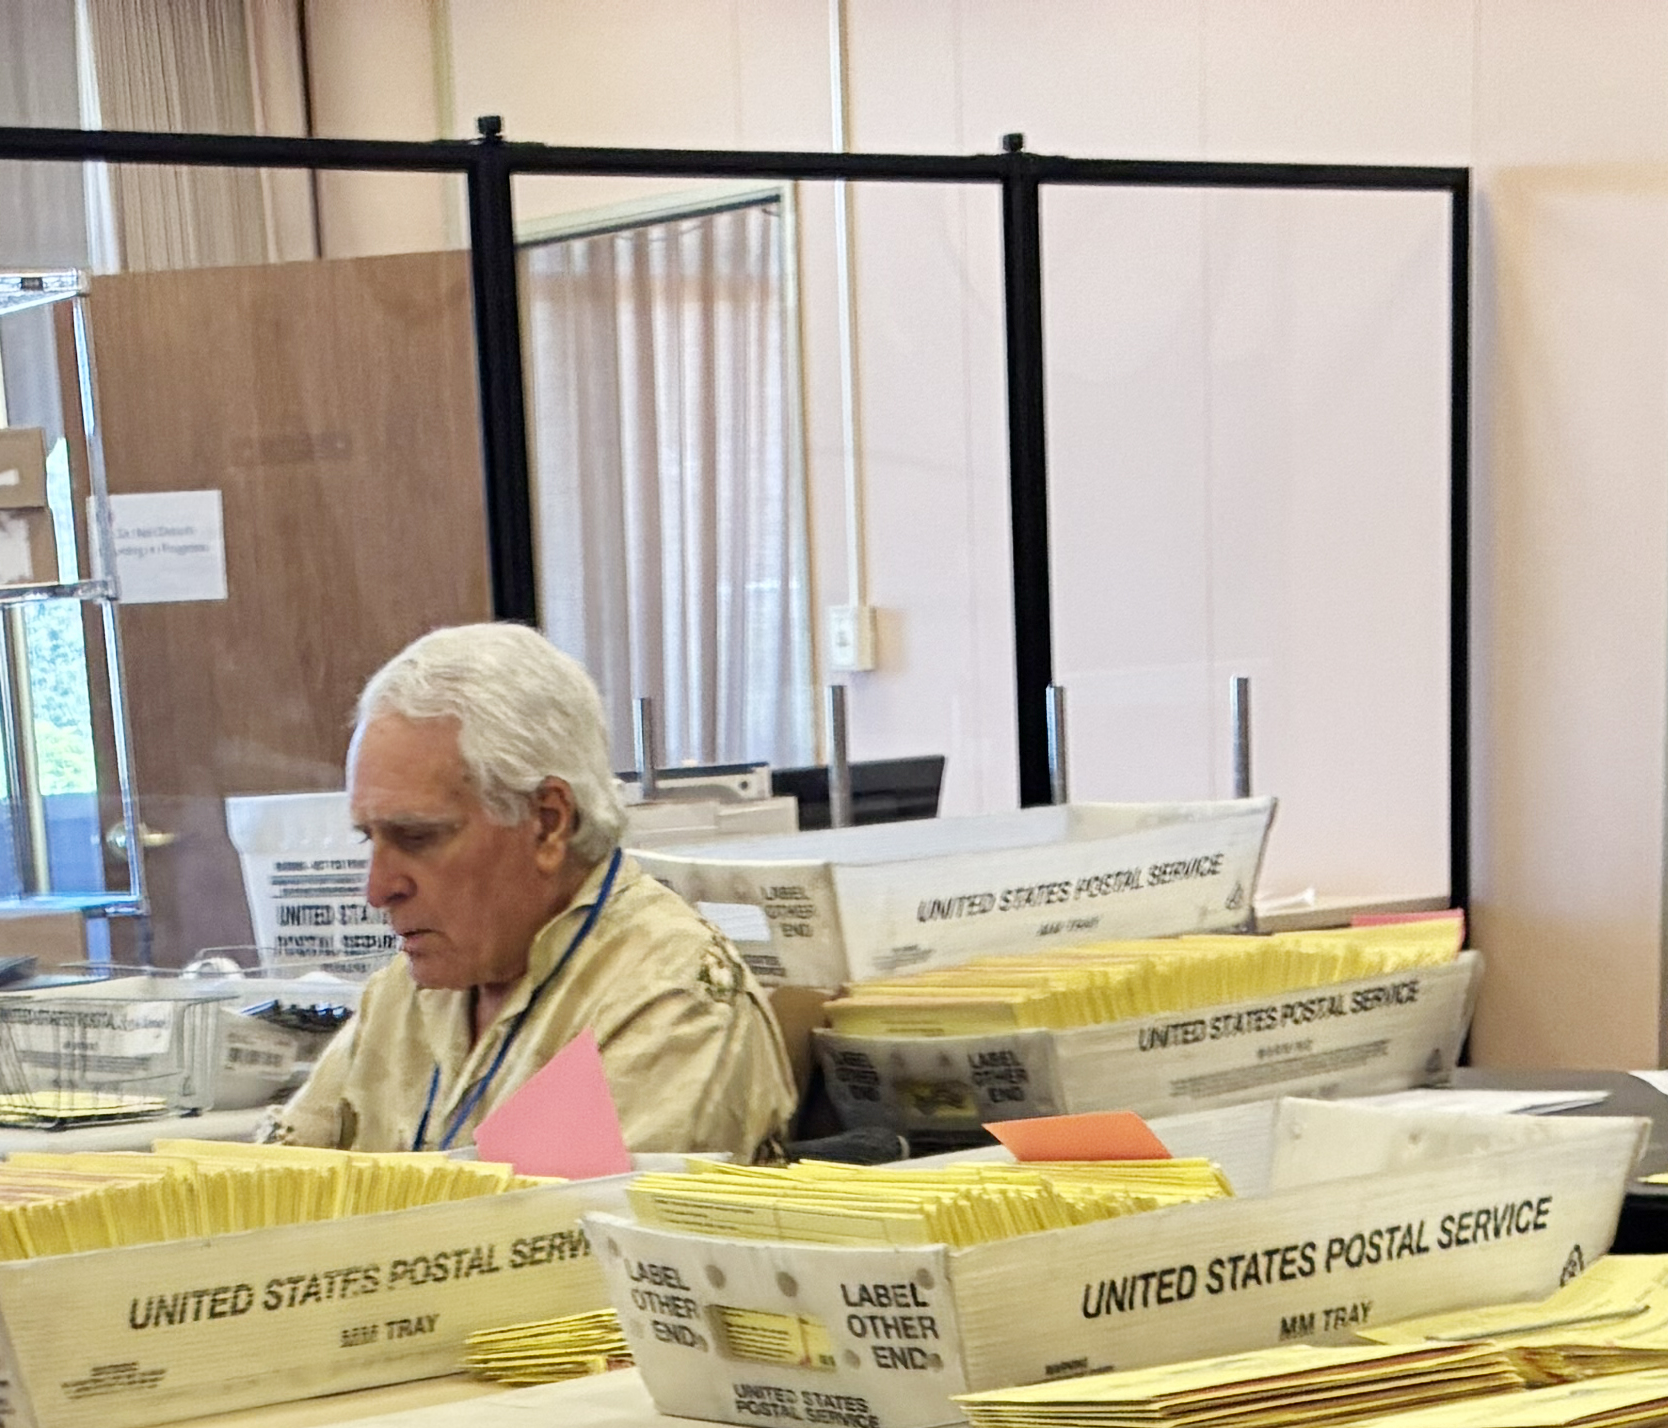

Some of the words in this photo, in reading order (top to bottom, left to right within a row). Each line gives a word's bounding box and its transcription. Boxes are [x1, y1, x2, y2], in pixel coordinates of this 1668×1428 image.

[917, 889, 993, 923] UNITED
[999, 878, 1070, 912] STATES
[1148, 853, 1224, 887] SERVICE
[1137, 1021, 1207, 1052] UNITED
[1210, 1009, 1276, 1041] STATES
[1279, 996, 1348, 1028] POSTAL
[1350, 978, 1420, 1015] SERVICE
[1082, 1263, 1196, 1319] UNITED
[1206, 1241, 1317, 1296] STATES
[1325, 1219, 1430, 1274] POSTAL
[1436, 1195, 1552, 1251] SERVICE
[128, 1282, 254, 1330] UNITED
[262, 1264, 381, 1312] STATES
[388, 1244, 499, 1293] POSTAL
[626, 1259, 690, 1291] LABEL
[633, 1289, 699, 1320] OTHER
[840, 1282, 929, 1309] LABEL
[386, 1313, 440, 1340] TRAY
[652, 1320, 696, 1348] END
[847, 1315, 940, 1340] OTHER
[1279, 1313, 1318, 1341] MM
[1322, 1300, 1372, 1333] TRAY
[871, 1346, 930, 1370] END
[734, 1384, 797, 1405] UNITED
[802, 1391, 870, 1413] STATES
[735, 1400, 802, 1421] POSTAL
